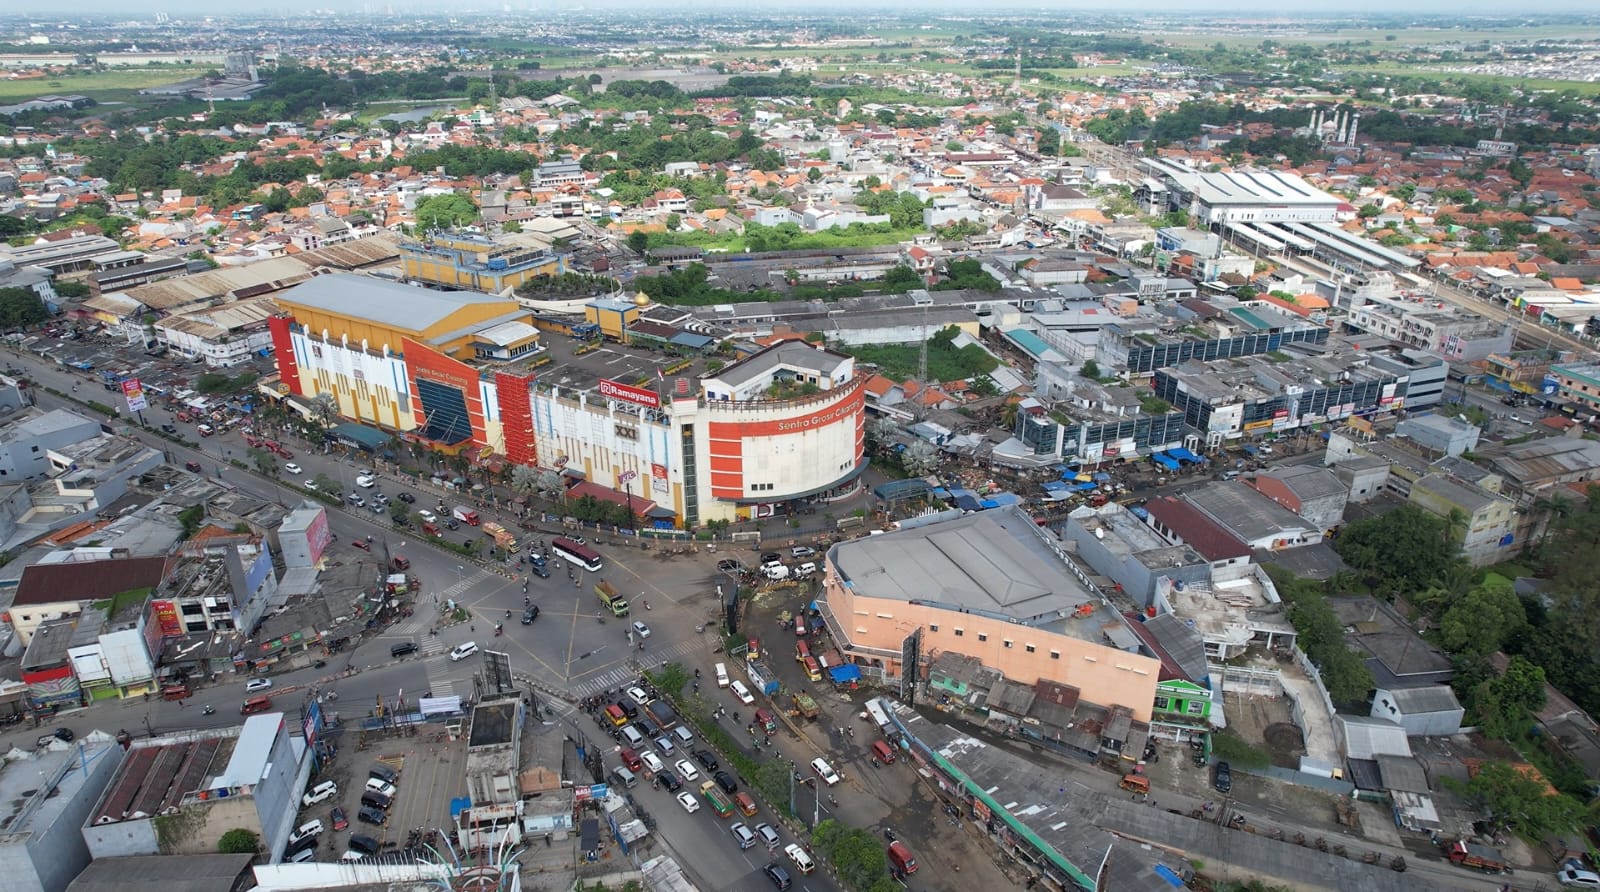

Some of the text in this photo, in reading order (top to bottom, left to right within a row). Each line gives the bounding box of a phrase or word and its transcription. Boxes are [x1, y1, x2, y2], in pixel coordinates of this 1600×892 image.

[611, 386, 656, 404] Ramayana
[778, 420, 809, 430] Sentra
[811, 413, 835, 425] Grosir
[615, 425, 636, 440] XXI
